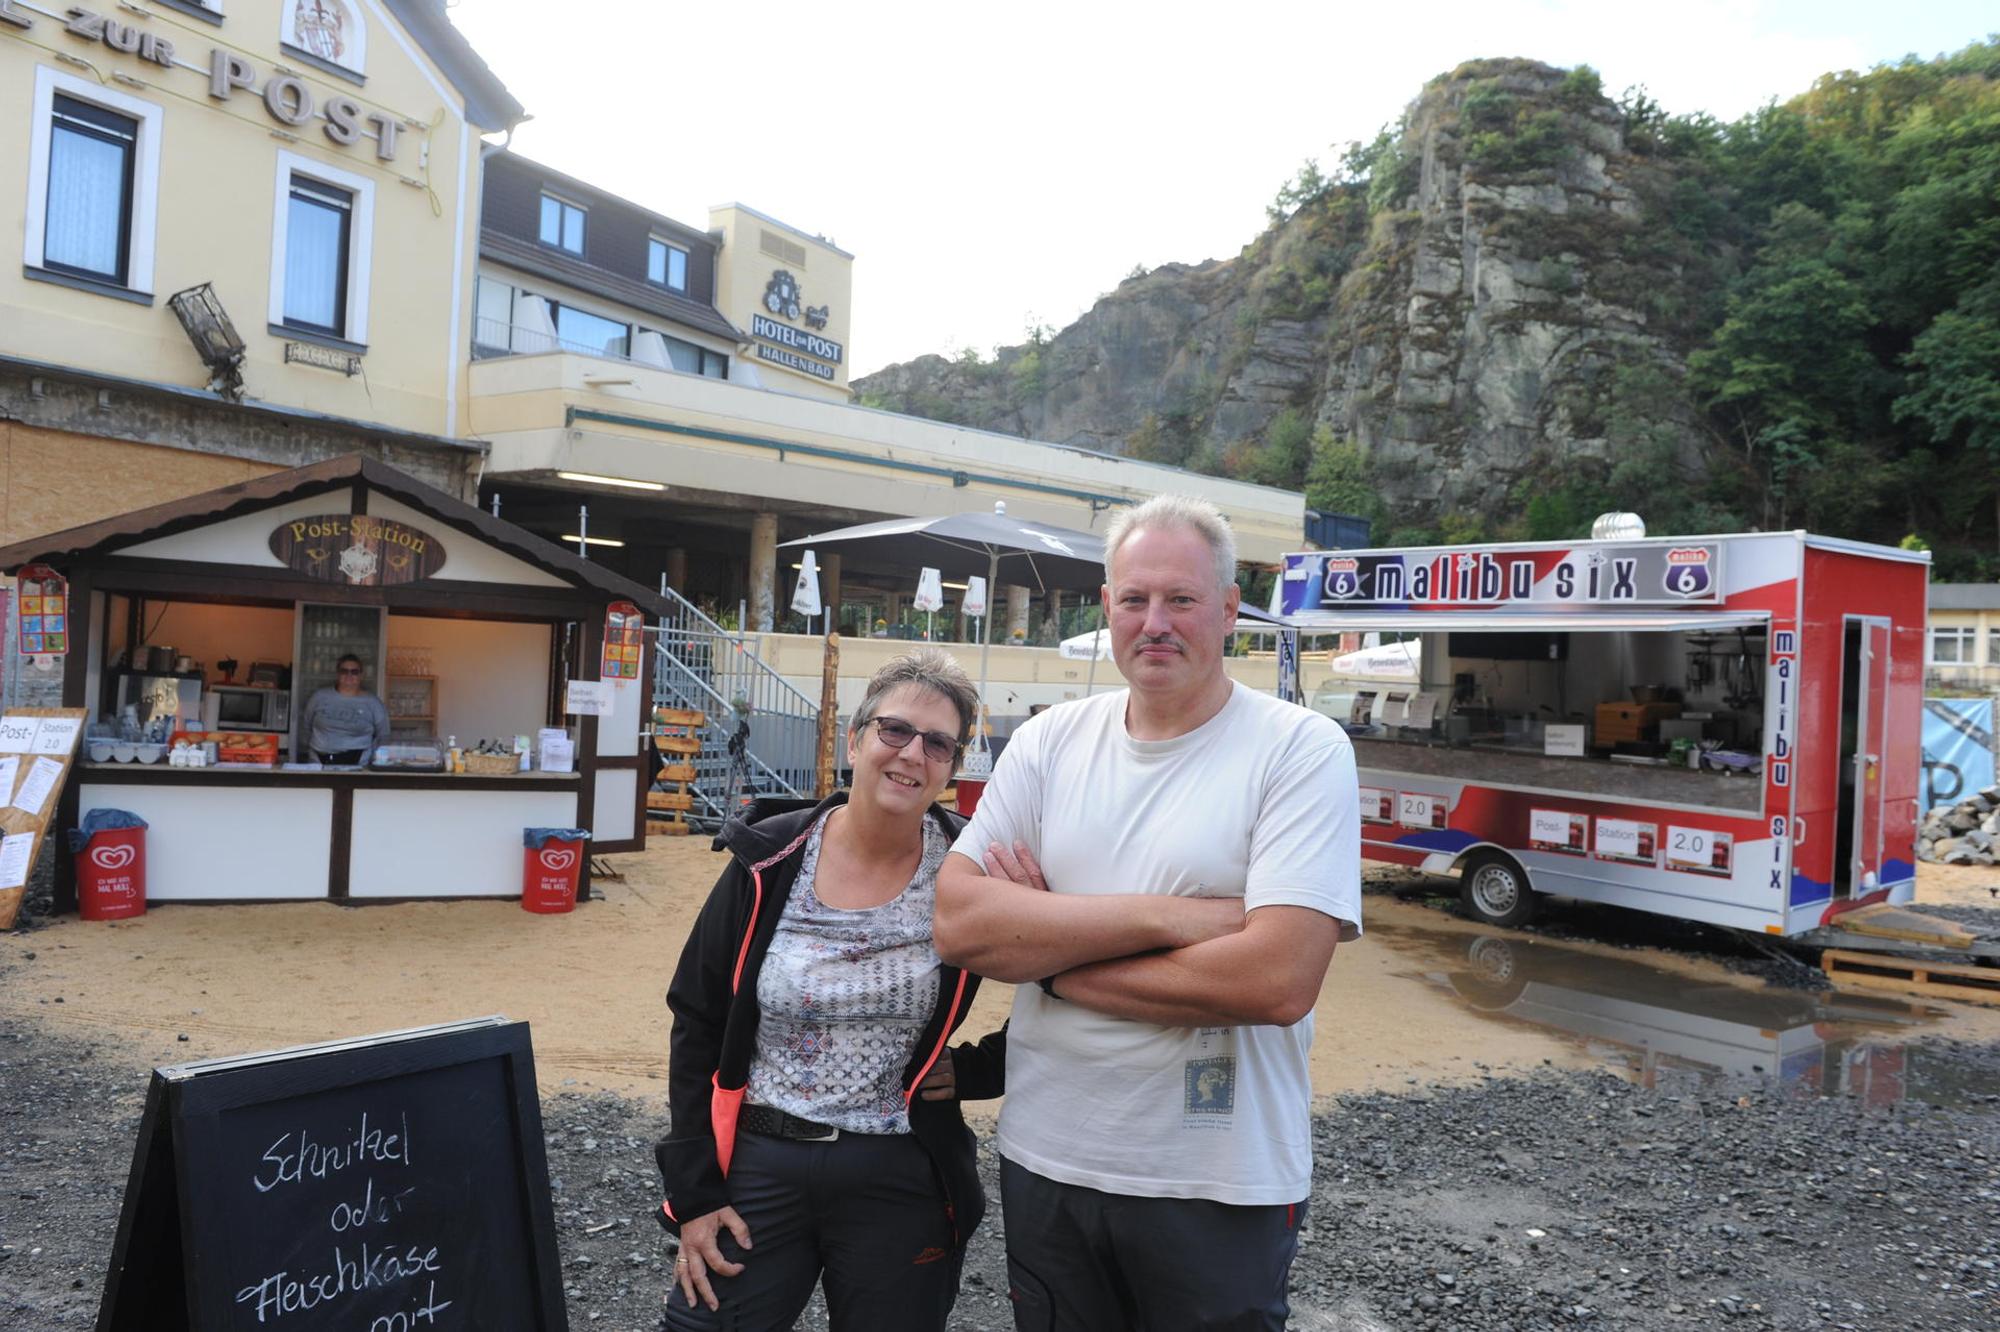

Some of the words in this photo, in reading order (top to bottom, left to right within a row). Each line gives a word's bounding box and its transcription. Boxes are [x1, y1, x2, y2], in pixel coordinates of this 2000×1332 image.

[64, 7, 175, 68] ZUR
[208, 48, 406, 161] POST
[754, 316, 798, 347] HOTEL
[807, 335, 840, 361] POST
[762, 343, 832, 378] HALLENBAD
[1336, 573, 1348, 594] 6
[1375, 553, 1534, 601] malibu
[1555, 552, 1638, 600] six
[1678, 566, 1696, 592] 6
[1774, 632, 1794, 784] malibu
[1404, 800, 1426, 816] 2.0
[1535, 819, 1563, 833] Post-
[1598, 826, 1636, 841] Station
[1674, 832, 1704, 853] 2.0
[1769, 816, 1785, 889] six
[254, 1111, 410, 1192] Schnitzel
[331, 1177, 416, 1232] oder
[235, 1242, 442, 1322] Fleischkäse
[370, 1280, 453, 1332] mit
